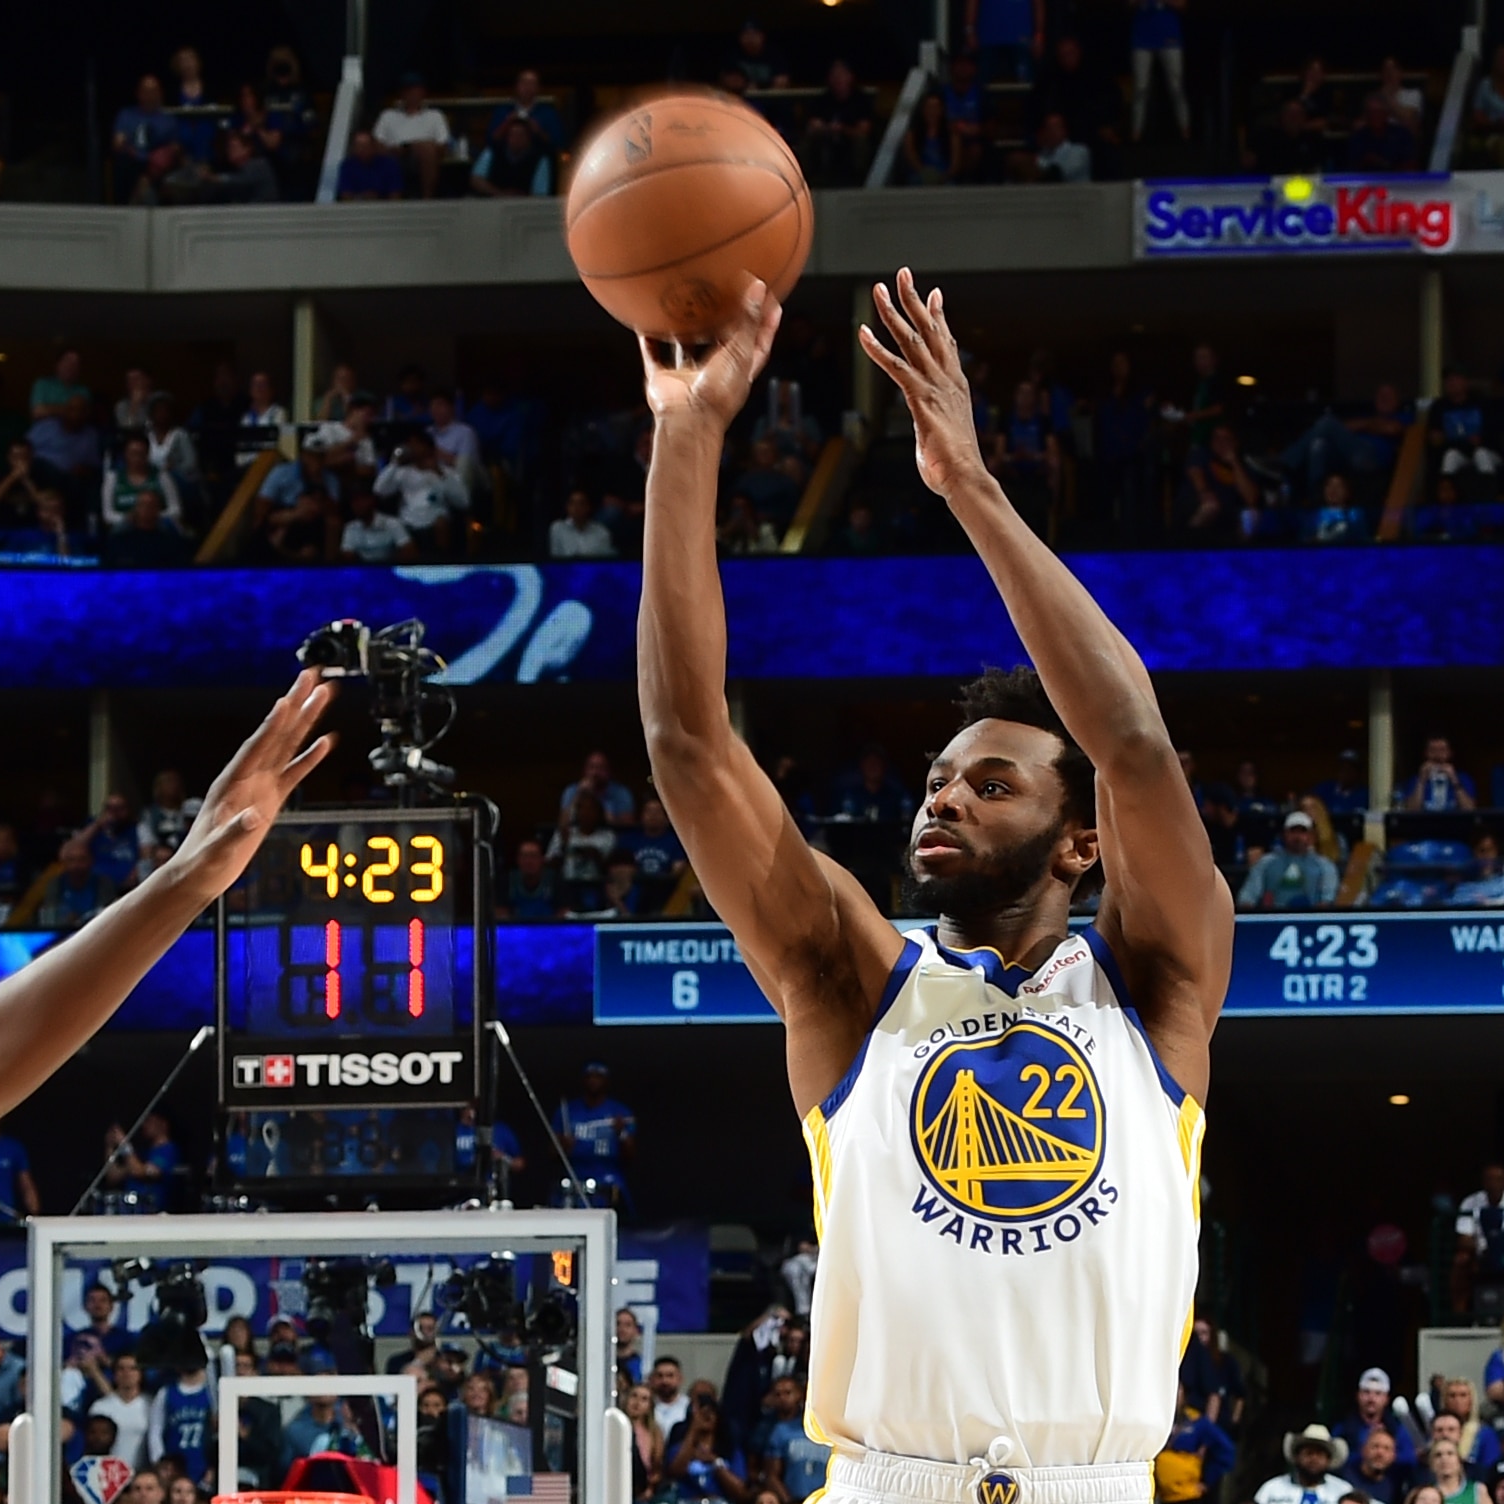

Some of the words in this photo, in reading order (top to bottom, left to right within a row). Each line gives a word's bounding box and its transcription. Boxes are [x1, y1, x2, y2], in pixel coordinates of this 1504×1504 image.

[300, 834, 445, 904] 4:23
[325, 918, 426, 1020] 11
[1270, 924, 1379, 967] 4:23
[672, 970, 700, 1010] 6
[1283, 974, 1344, 1003] QTR
[1350, 975, 1367, 1001] 2
[913, 1010, 1020, 1060] GOLDEN
[296, 1051, 463, 1086] TISSOT
[1019, 1063, 1088, 1119] 22
[910, 1177, 1120, 1256] WARRIORS
